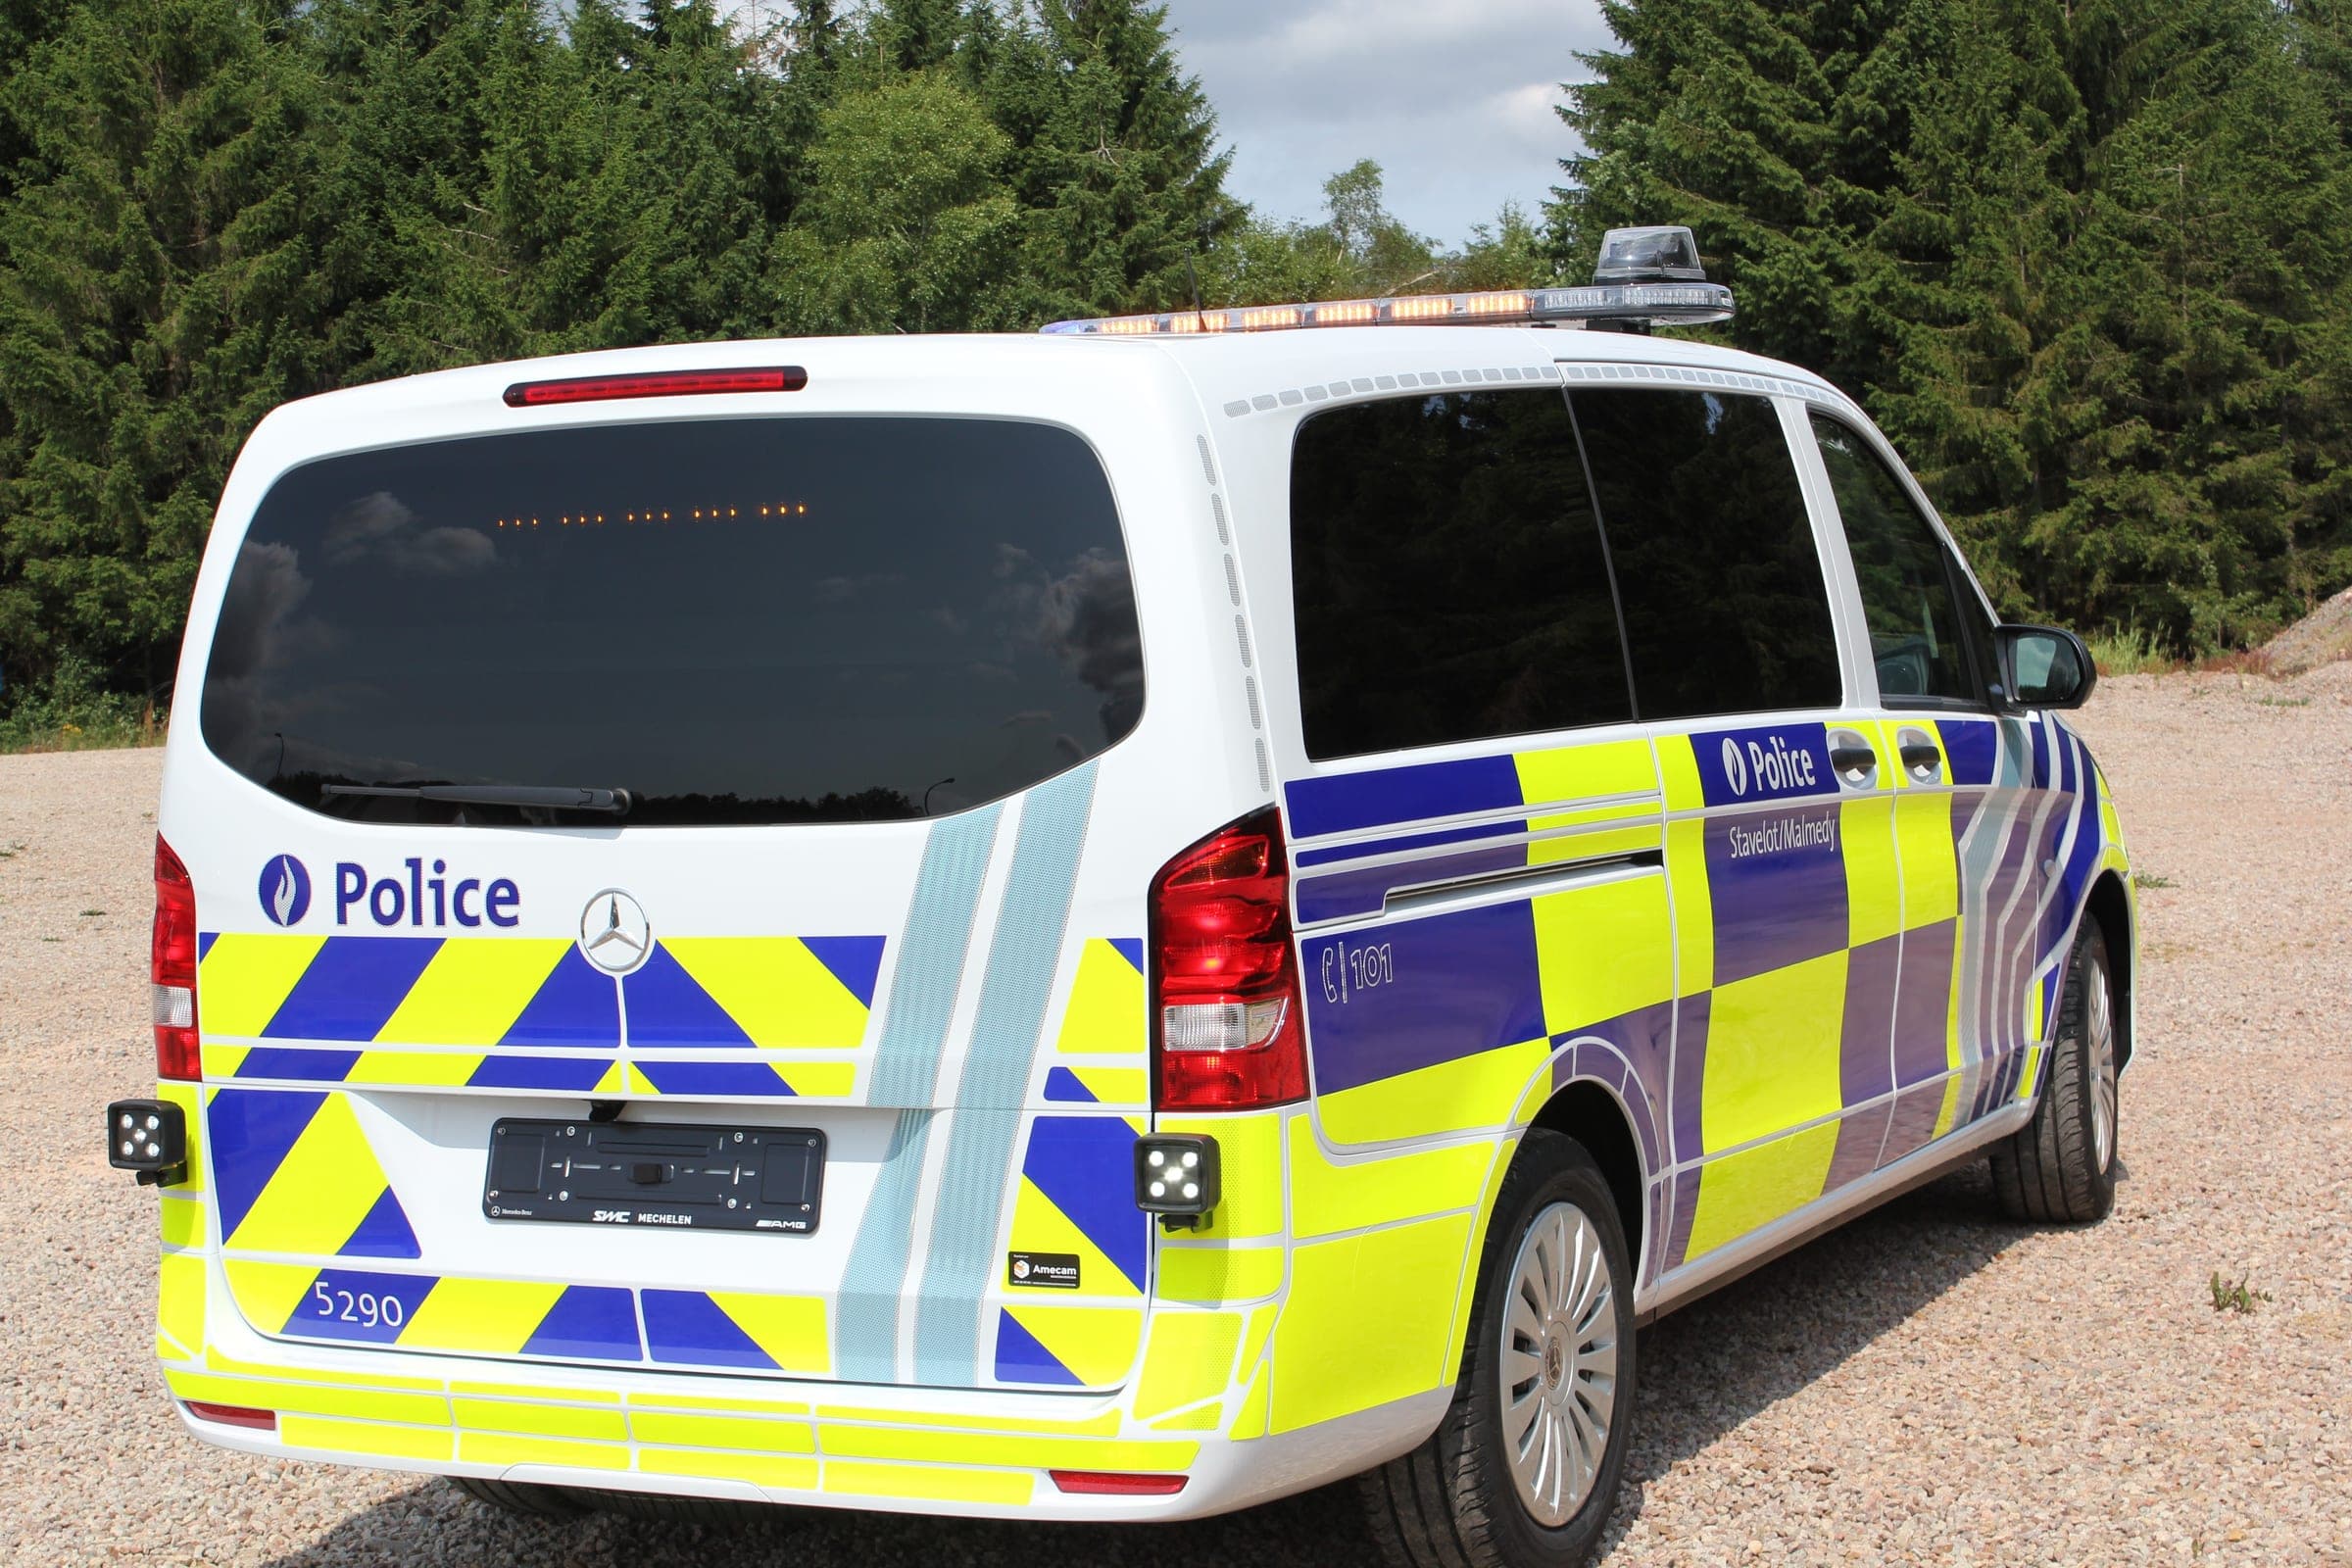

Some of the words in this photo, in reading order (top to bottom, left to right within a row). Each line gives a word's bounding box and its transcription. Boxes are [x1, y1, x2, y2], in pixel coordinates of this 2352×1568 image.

[1746, 735, 1816, 792] Police
[1730, 810, 1835, 858] Stavelot/Malmedy
[335, 857, 520, 928] Police
[1350, 943, 1393, 990] 101
[638, 1212, 692, 1225] MECHELEN
[1032, 1264, 1077, 1275] Amecam
[315, 1281, 403, 1328] 5290
